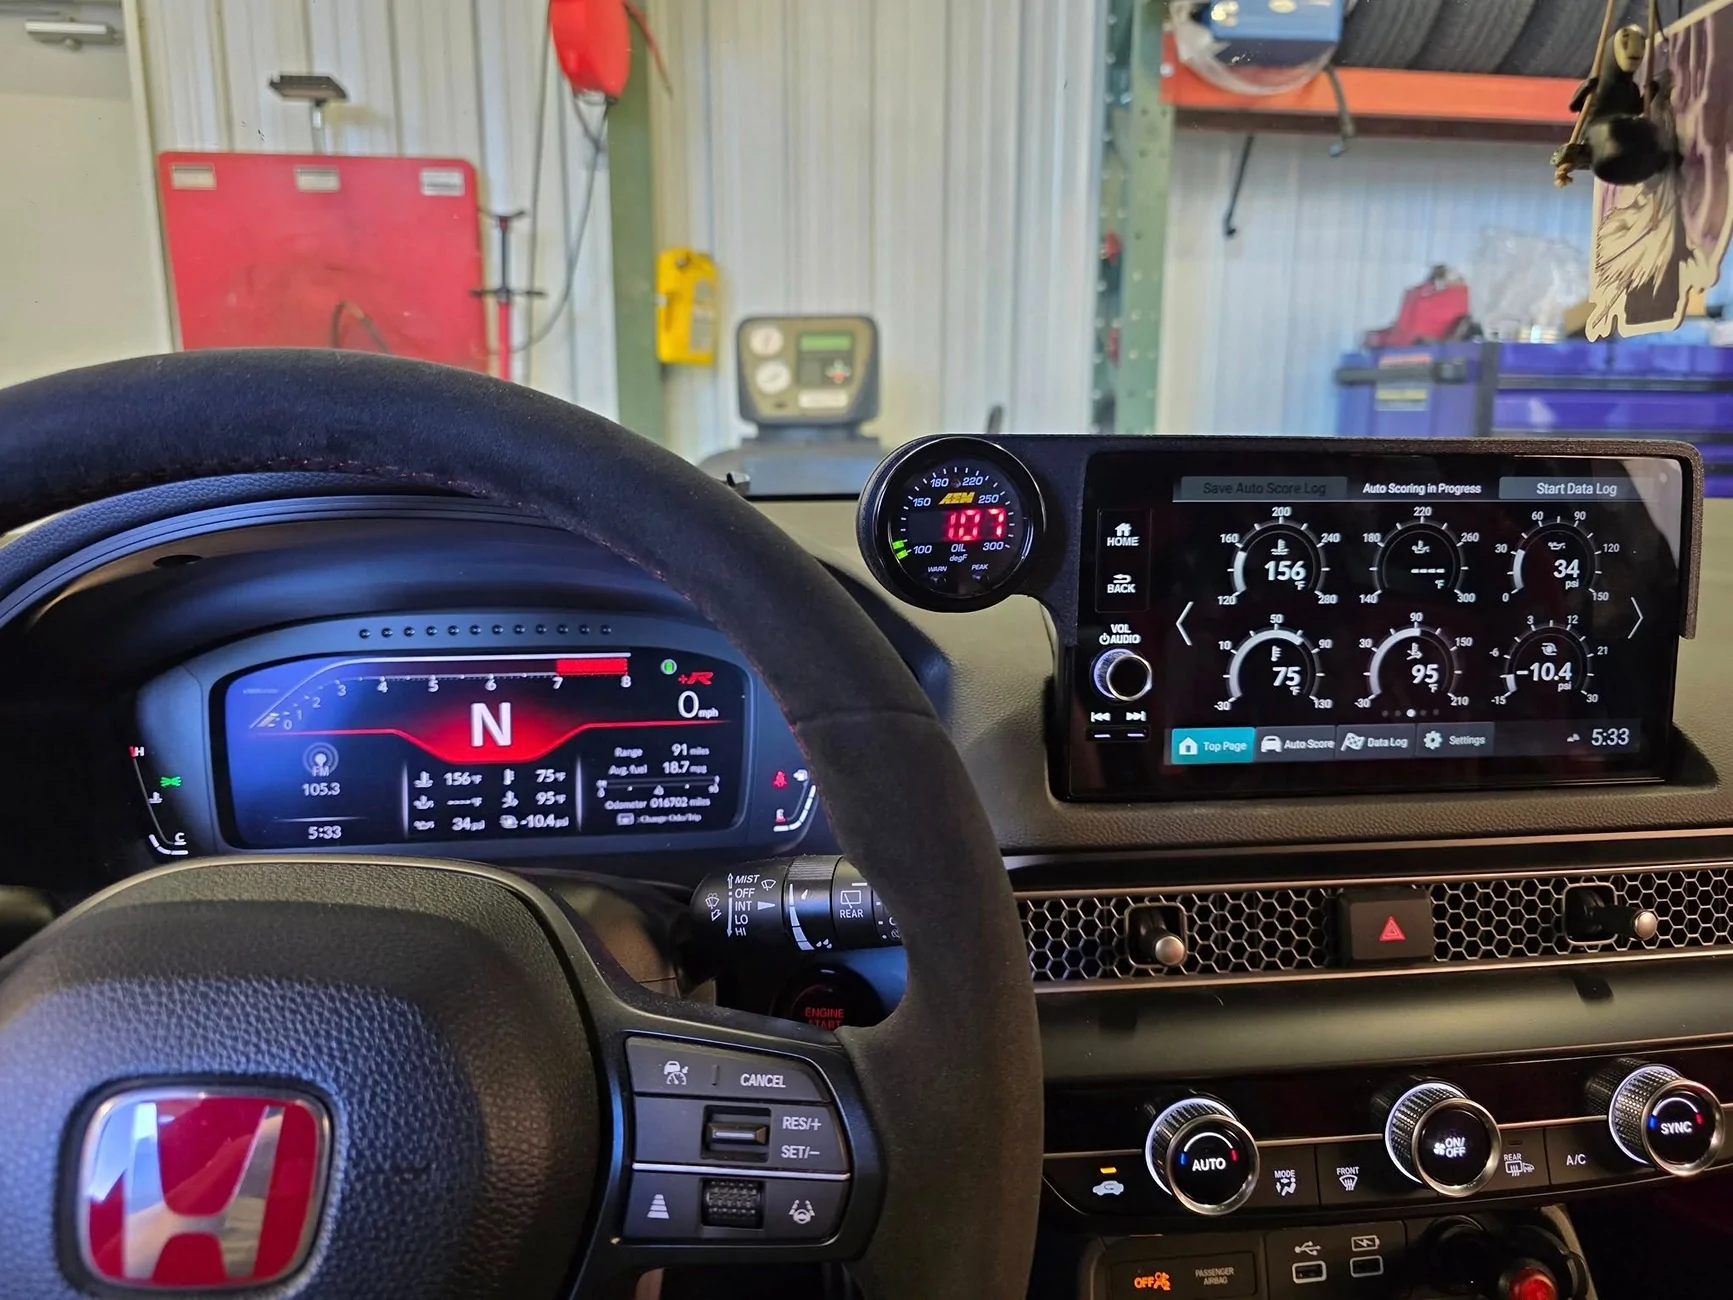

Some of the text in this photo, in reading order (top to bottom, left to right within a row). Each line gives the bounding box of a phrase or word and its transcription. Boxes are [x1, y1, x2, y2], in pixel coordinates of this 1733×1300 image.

[930, 478, 948, 488] 180
[962, 477, 984, 486] 220
[1203, 482, 1326, 496] Save Auto Score Log
[1362, 483, 1482, 496] Auto Scoring in Progress
[1536, 483, 1617, 497] Start Data Log
[912, 497, 931, 507] 150
[938, 491, 976, 505] AEM
[978, 494, 999, 504] 250
[1272, 507, 1292, 516] 200
[1414, 507, 1432, 516] 220
[1532, 511, 1544, 521] 60
[1574, 511, 1586, 521] 90
[947, 508, 1005, 541] 107
[1106, 536, 1140, 547] HOME
[1220, 534, 1240, 544] 160
[1321, 534, 1341, 543] 240
[1362, 534, 1381, 543] 180
[1460, 532, 1480, 542] 260
[913, 545, 932, 554] 100
[950, 544, 966, 552] OIL
[982, 542, 1004, 550] 300
[1494, 544, 1508, 553] 30
[1603, 543, 1620, 553] 120
[950, 554, 968, 562] degF
[1264, 560, 1306, 581] 156
[1553, 560, 1580, 578] 34
[1107, 584, 1136, 594] BACK
[1565, 579, 1580, 590] psi
[1218, 596, 1237, 605] 120
[1318, 594, 1338, 604] 280
[1359, 594, 1378, 604] 140
[1457, 593, 1476, 602] 300
[1502, 593, 1509, 602] 0
[1592, 592, 1610, 601] 150
[1270, 614, 1284, 624] 50
[1410, 612, 1423, 622] 90
[1526, 616, 1534, 624] 3
[1567, 615, 1579, 624] 12
[1110, 624, 1132, 633] VOL
[1110, 634, 1142, 644] AUDIO
[1359, 638, 1372, 648] 30
[1455, 637, 1473, 647] 150
[1218, 640, 1232, 650] 10
[1318, 640, 1332, 649] 90
[1489, 648, 1500, 658] -6
[1597, 646, 1609, 655] 21
[1272, 666, 1301, 686] 75
[1411, 664, 1439, 684] 95
[1516, 662, 1572, 682] -10.4
[428, 680, 439, 692] 5
[485, 680, 496, 691] 6
[553, 677, 564, 689] 7
[621, 676, 632, 688] 8
[1558, 682, 1572, 692] psi
[337, 685, 347, 696] 3
[377, 682, 388, 693] 4
[313, 697, 321, 708] 2
[1314, 699, 1333, 708] 130
[1354, 698, 1372, 708] -30
[1450, 696, 1470, 706] 210
[1490, 696, 1506, 705] -15
[1586, 694, 1598, 703] 30
[1214, 701, 1232, 711] -30
[298, 710, 302, 720] 1
[284, 720, 292, 730] 0
[470, 702, 512, 747] N
[1448, 734, 1486, 746] Settings
[1590, 728, 1630, 746] 5:33
[1204, 740, 1247, 752] Top Page
[1284, 738, 1335, 749] Auto Score
[1367, 736, 1408, 749] Data Log
[614, 746, 644, 758] Range
[671, 743, 688, 756] 91
[312, 766, 330, 777] FM
[628, 764, 648, 774] fuel
[662, 760, 690, 774] 18.7
[302, 782, 340, 796] 105.3
[308, 826, 342, 839] 5:33
[734, 874, 760, 884] MIST
[734, 888, 755, 898] OFF
[734, 901, 752, 912] INT
[840, 909, 864, 918] REAR
[734, 914, 748, 925] LO
[735, 928, 747, 936] HI
[805, 1006, 844, 1018] ENGINE
[740, 1074, 786, 1088] CANCEL
[782, 1116, 822, 1131] RES/+
[1660, 1122, 1692, 1135] SYNC
[1445, 1136, 1466, 1148] ON/
[1446, 1147, 1466, 1158] OFF
[1504, 1154, 1522, 1162] REAR
[1566, 1154, 1586, 1166] A/C
[1192, 1157, 1226, 1172] AUTO
[1274, 1170, 1296, 1179] MODE
[1336, 1166, 1360, 1176] FRONT
[1195, 1267, 1234, 1277] PASSENGER
[1134, 1276, 1154, 1288] OFF
[1204, 1276, 1228, 1286] AIRBAG
